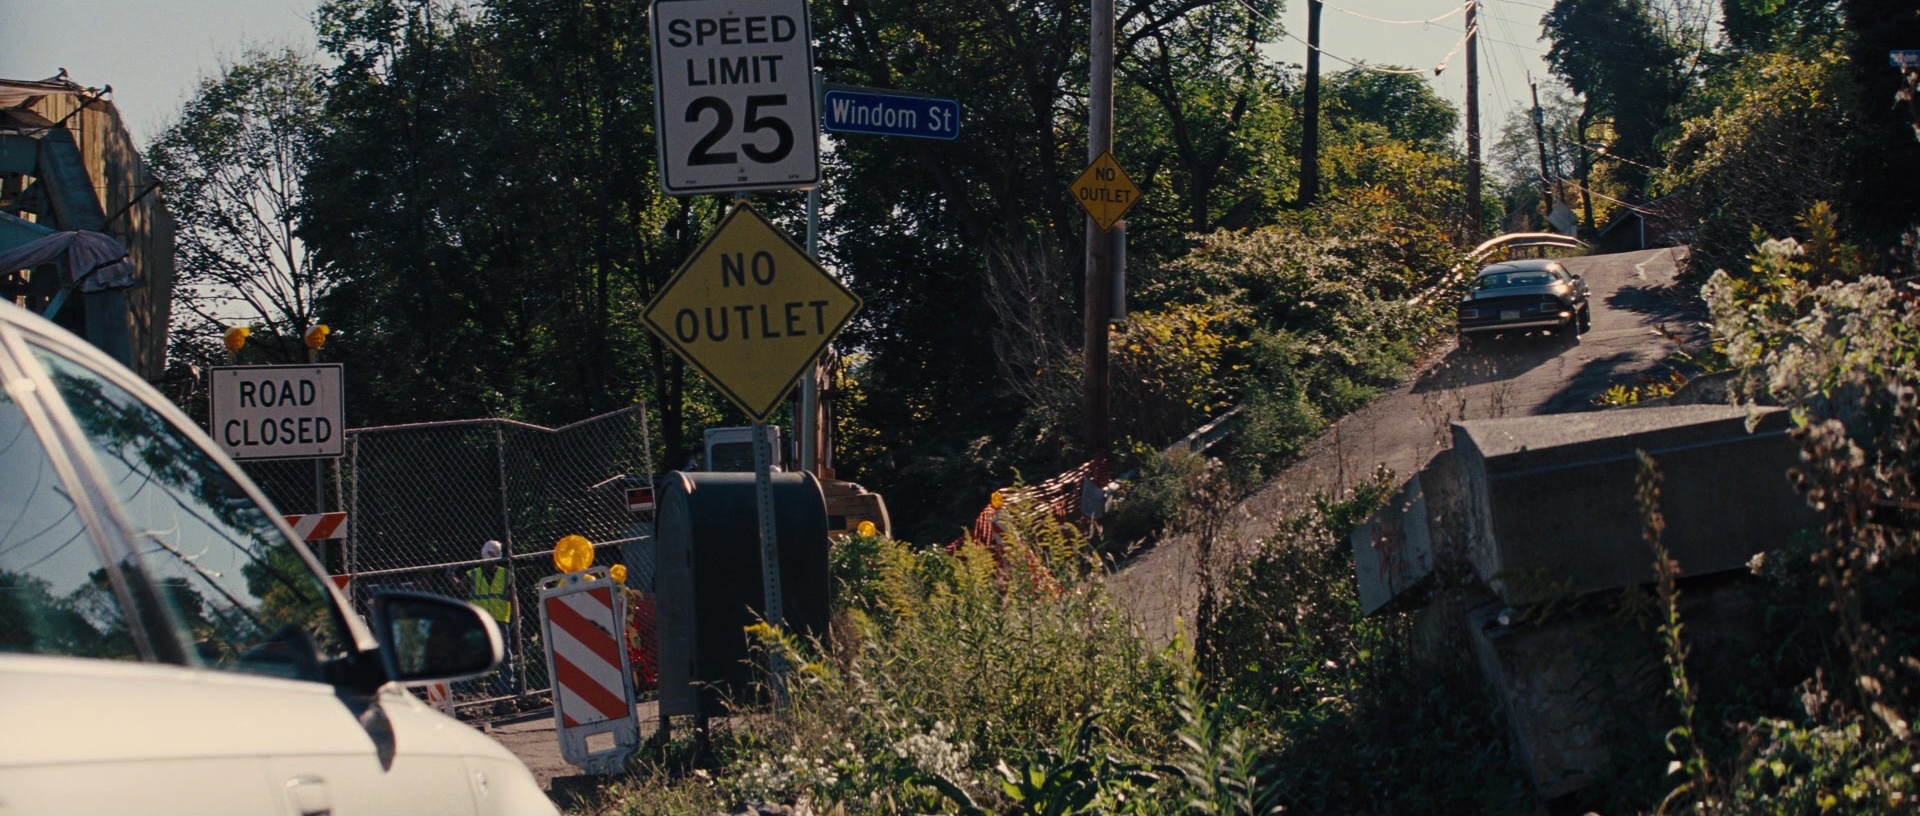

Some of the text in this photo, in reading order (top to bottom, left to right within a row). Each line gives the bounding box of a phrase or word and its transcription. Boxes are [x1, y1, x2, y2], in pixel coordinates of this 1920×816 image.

[667, 15, 796, 47] SPEED
[687, 55, 783, 86] LIMIT
[684, 94, 794, 166] 25
[832, 98, 951, 132] Windom St
[1096, 167, 1115, 181] NO
[1080, 187, 1131, 203] OUTLET
[720, 251, 776, 287] NO
[675, 300, 829, 344] OUTLET
[240, 379, 316, 408] ROAD
[224, 417, 331, 447] CLOSED
